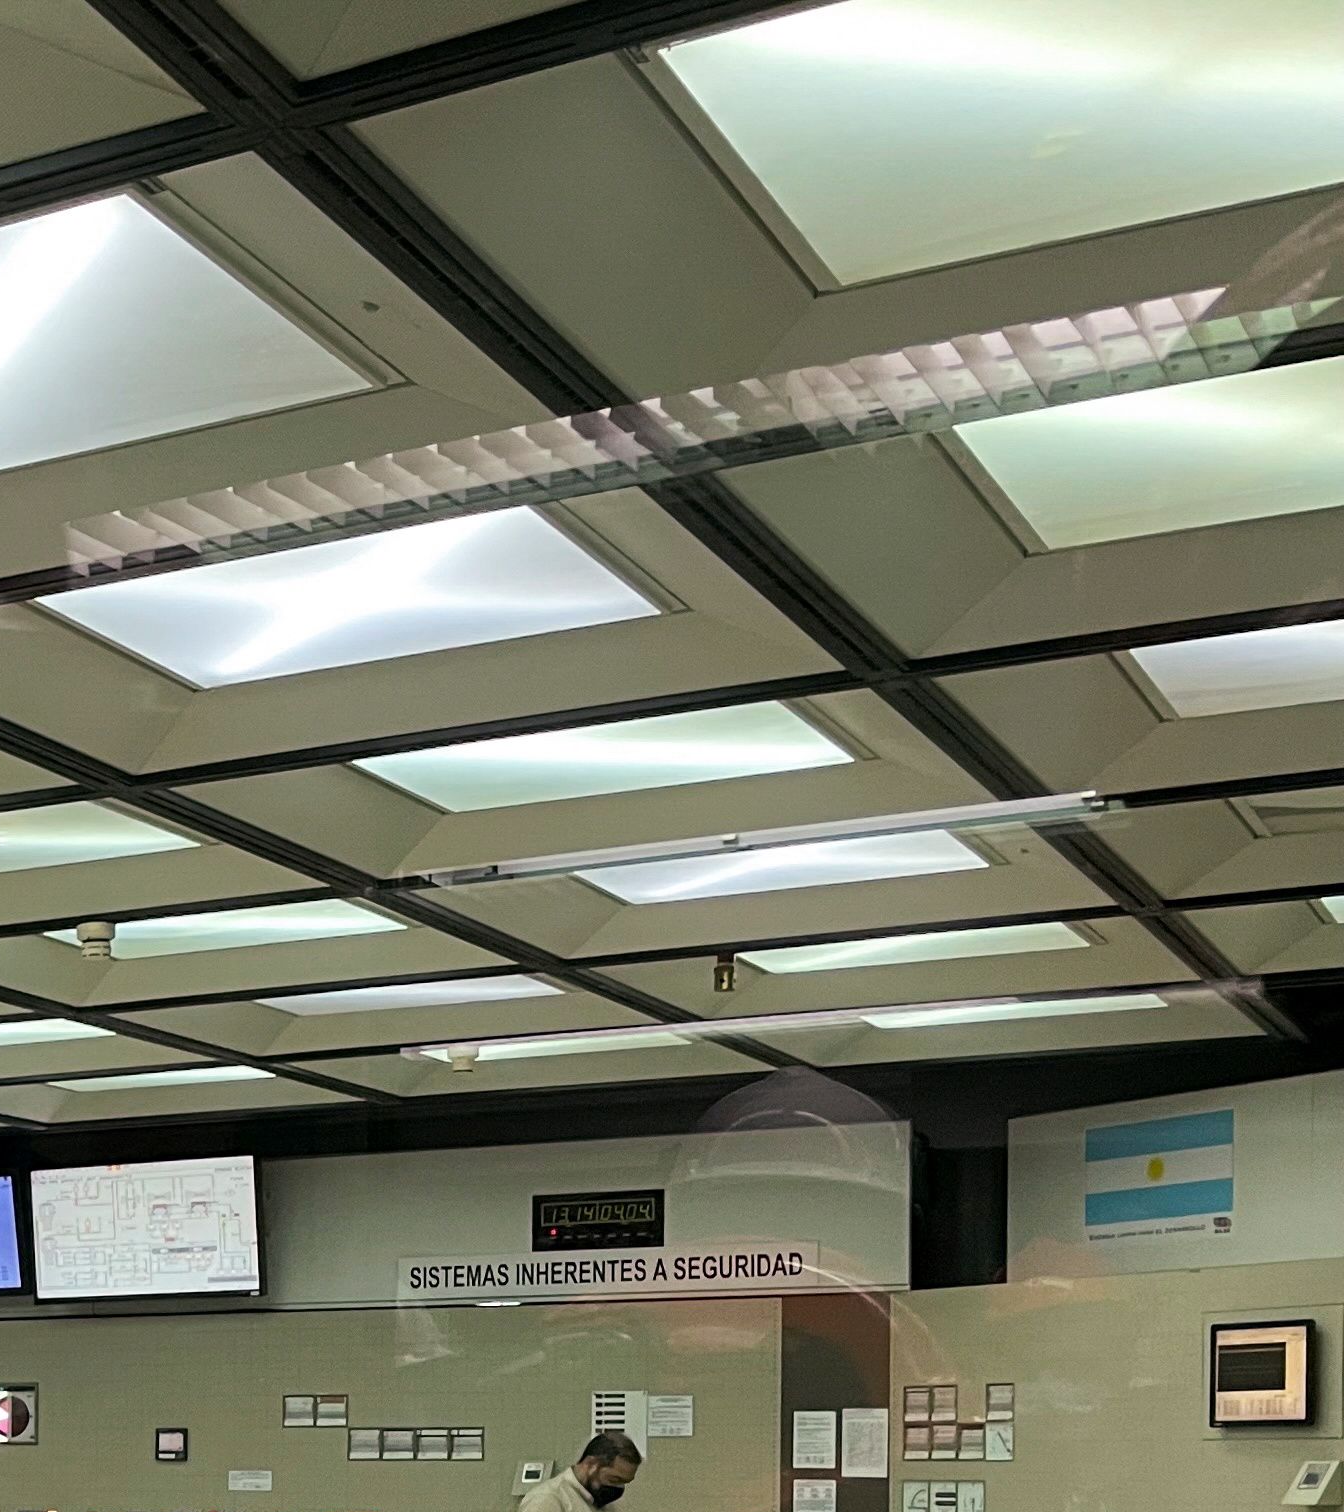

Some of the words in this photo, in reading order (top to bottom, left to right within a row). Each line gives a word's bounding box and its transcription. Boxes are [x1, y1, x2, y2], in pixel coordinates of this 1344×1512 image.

[410, 1263, 510, 1289] SISTEMAS
[516, 1258, 647, 1285] INHERENTES
[652, 1258, 668, 1281] A
[673, 1252, 803, 1280] SEGURIDAD
